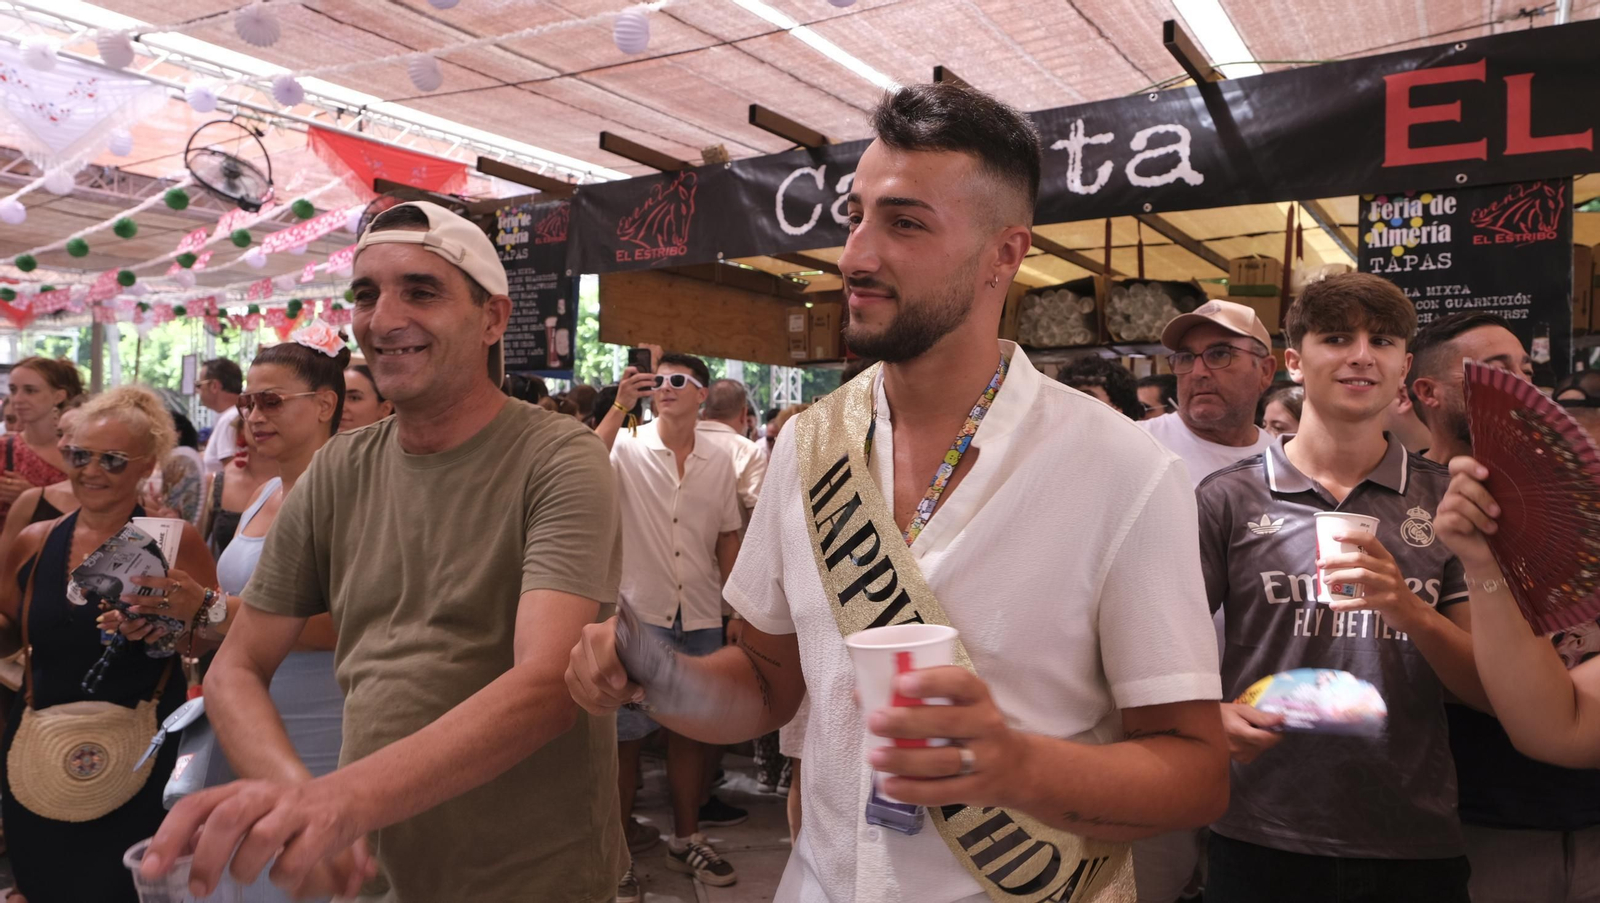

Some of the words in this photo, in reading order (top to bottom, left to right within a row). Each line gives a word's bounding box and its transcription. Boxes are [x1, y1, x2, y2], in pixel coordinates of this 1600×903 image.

[1382, 57, 1594, 168] EL
[1370, 197, 1423, 222] Feria
[1429, 194, 1457, 216] de
[1368, 220, 1452, 249] Almería
[1473, 234, 1492, 245] EL
[1495, 231, 1557, 244] ESTRIBO
[616, 249, 632, 262] EL
[635, 245, 688, 261] ESTRIBO
[1370, 252, 1453, 274] TAPAS
[1415, 299, 1440, 311] CON
[1445, 292, 1532, 309] GUARNICIÓN
[1426, 284, 1472, 297] MIXTA
[1260, 570, 1442, 608] Emes
[1293, 608, 1325, 637] FLY
